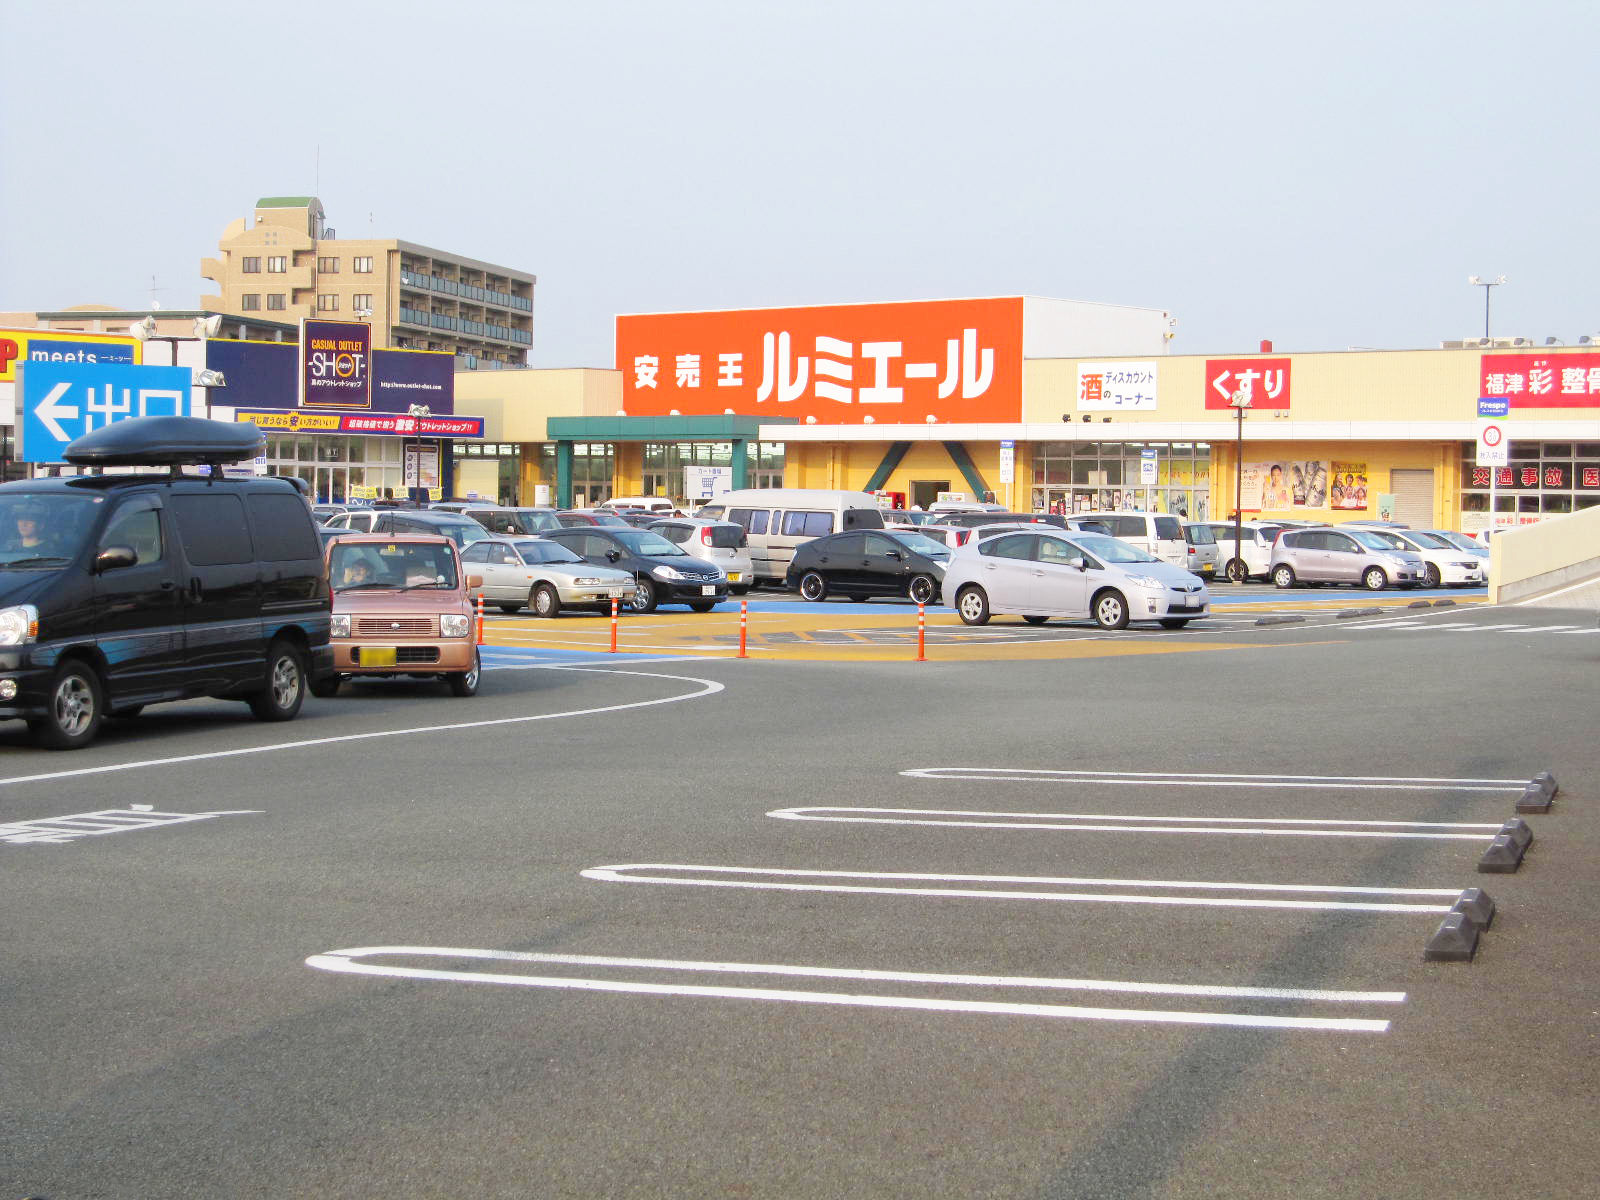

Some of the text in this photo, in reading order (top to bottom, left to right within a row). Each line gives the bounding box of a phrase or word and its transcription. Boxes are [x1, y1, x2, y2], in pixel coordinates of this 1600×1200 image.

[312, 339, 362, 352] CASUAL OUTLET
[33, 350, 97, 363] meets
[634, 329, 994, 403] 安売王 ルミエール
[1106, 371, 1154, 384] ディスカウント
[1213, 369, 1283, 405] くすり
[1486, 373, 1523, 394] 福津
[1529, 368, 1552, 394] 彩
[1115, 392, 1154, 405] コーナー
[86, 384, 182, 435] 出口
[1472, 467, 1562, 487] 交通事故
